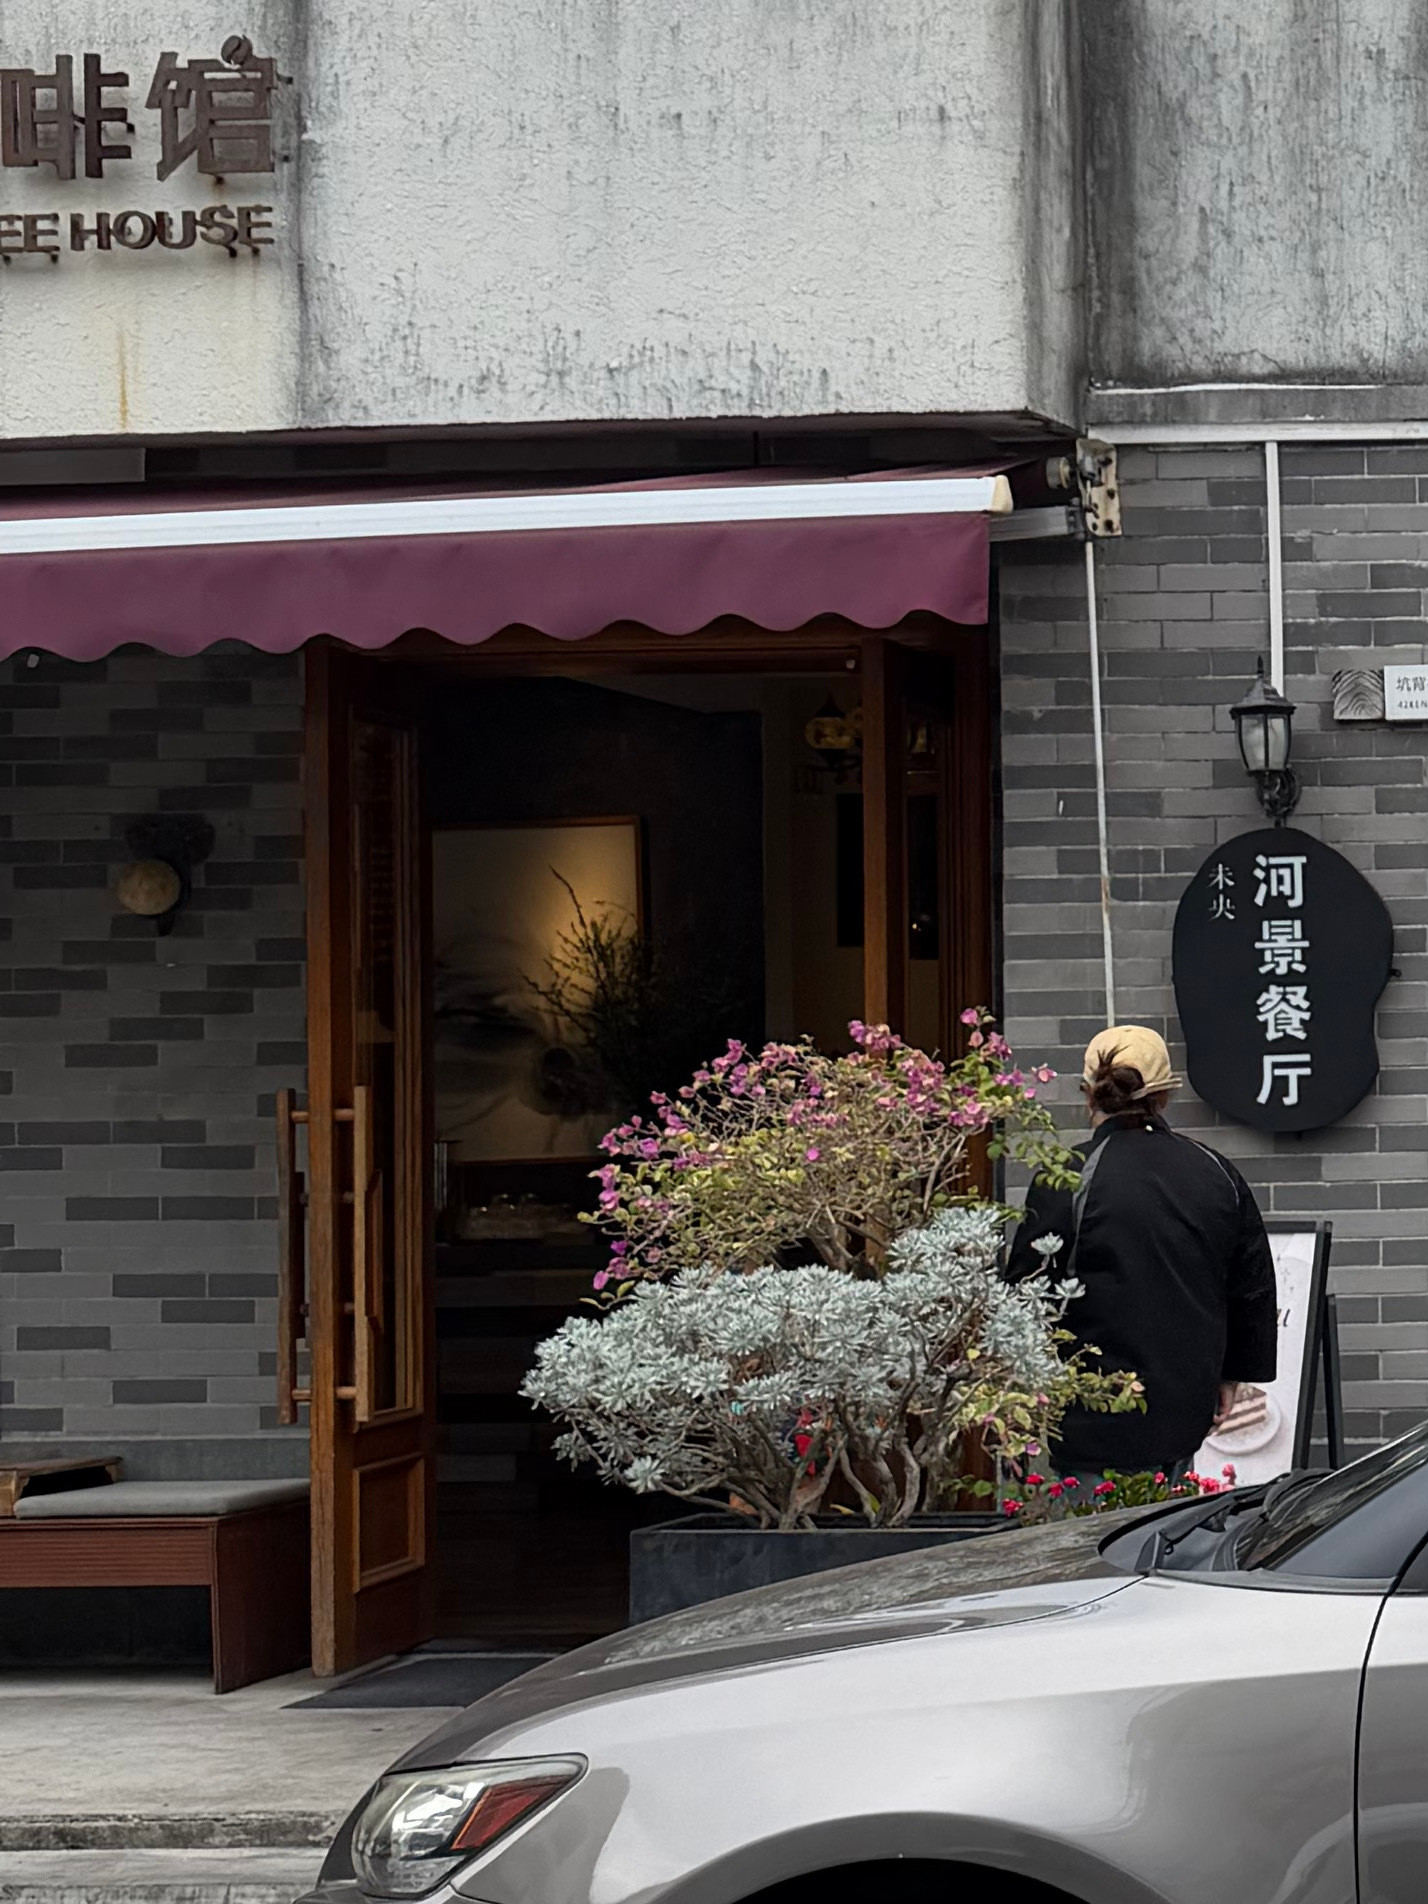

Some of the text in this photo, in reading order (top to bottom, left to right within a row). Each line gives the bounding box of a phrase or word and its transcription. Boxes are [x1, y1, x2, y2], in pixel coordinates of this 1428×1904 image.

[70, 204, 275, 251] HOUSE
[1207, 863, 1236, 922] 未央
[1252, 854, 1312, 1106] 河景餐厅
